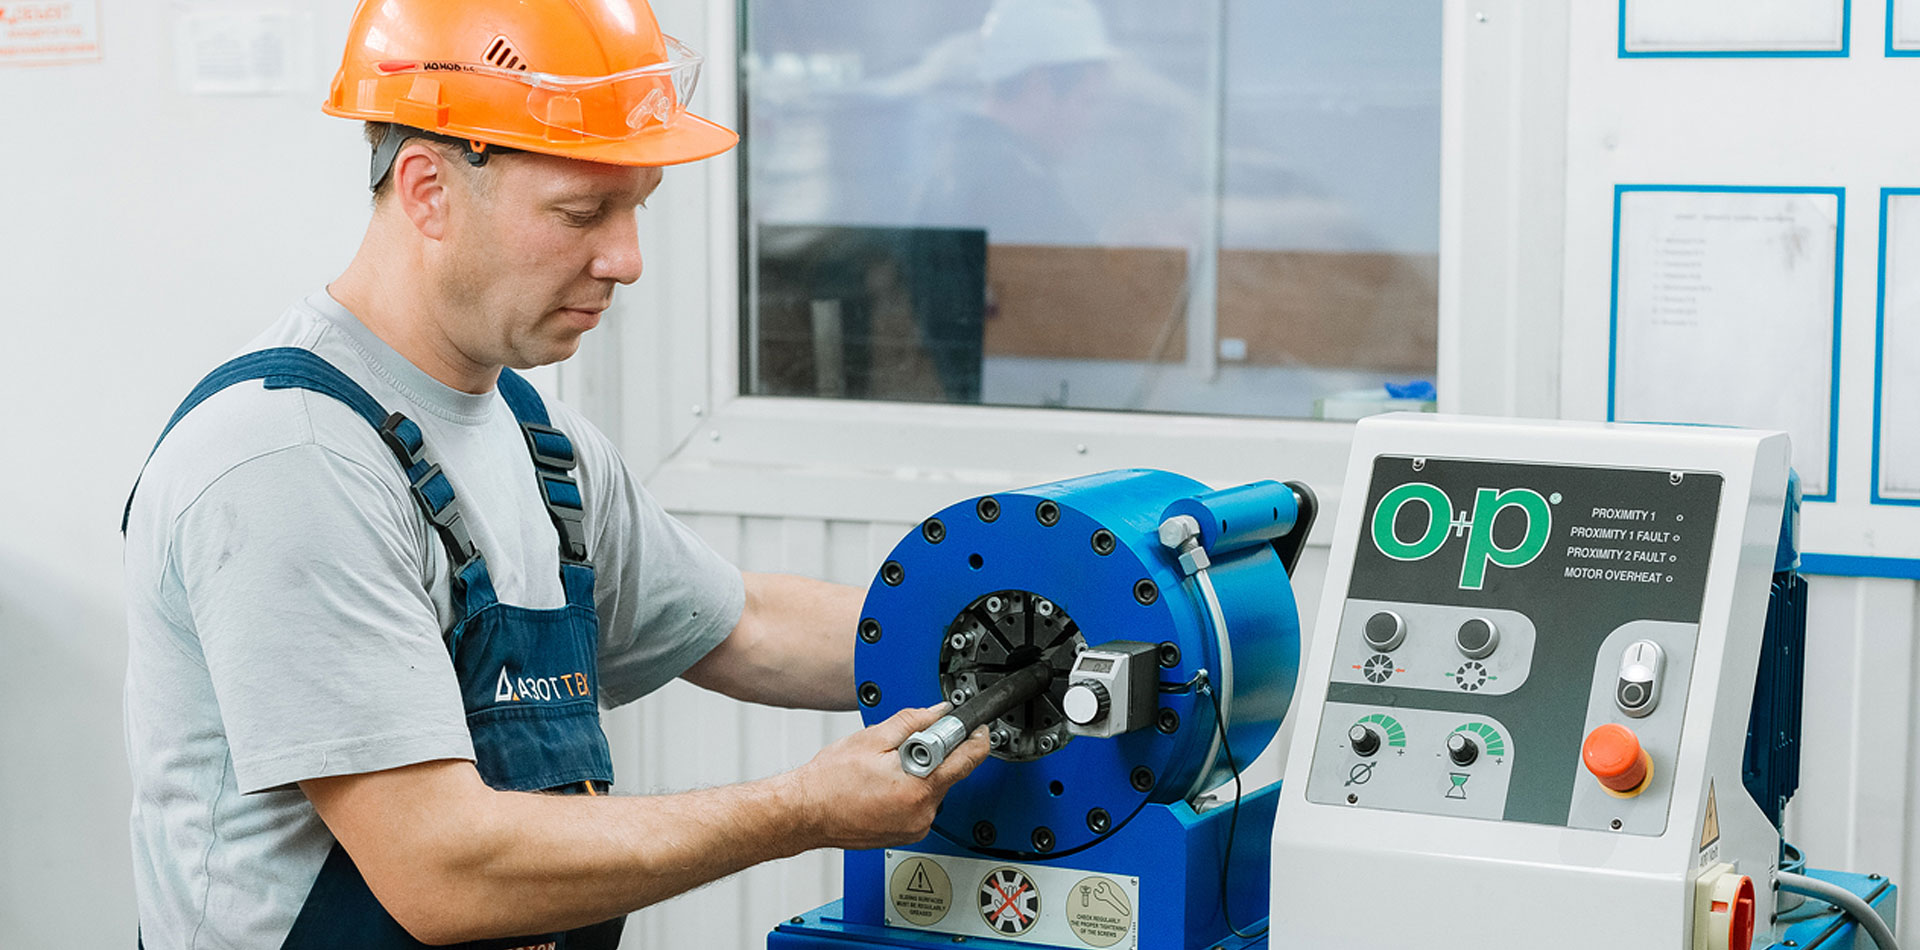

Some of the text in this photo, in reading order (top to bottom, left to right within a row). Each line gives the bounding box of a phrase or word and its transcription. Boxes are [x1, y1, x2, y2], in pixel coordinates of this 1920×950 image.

[1591, 507, 1656, 521] PROXIMITY 1
[1570, 526, 1671, 543] PROXIMITY 1 FAULT
[1566, 546, 1667, 563] PROXIMITY 2 FAULT
[1564, 567, 1663, 583] MOTOR OVERHEAT
[1093, 916, 1121, 924] REGULARLY
